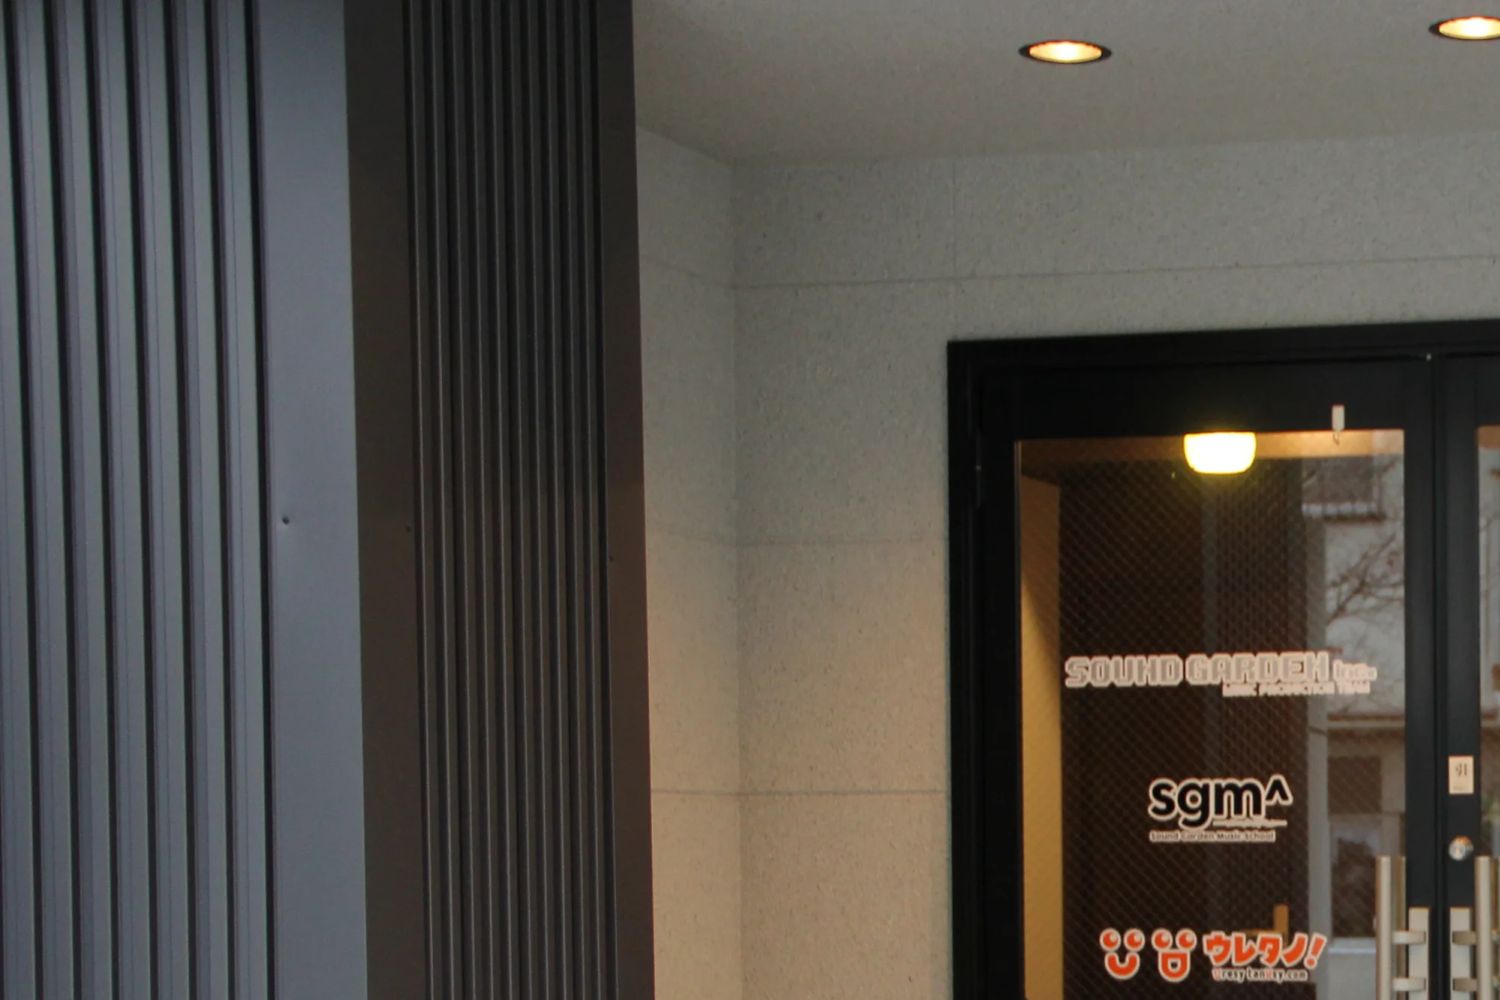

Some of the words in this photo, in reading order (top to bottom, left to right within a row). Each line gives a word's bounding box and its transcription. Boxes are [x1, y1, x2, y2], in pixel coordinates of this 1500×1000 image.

[1065, 655, 1184, 688] SOUND
[1186, 650, 1331, 685] GARDEN
[1203, 930, 1327, 970] ウレタノ!
